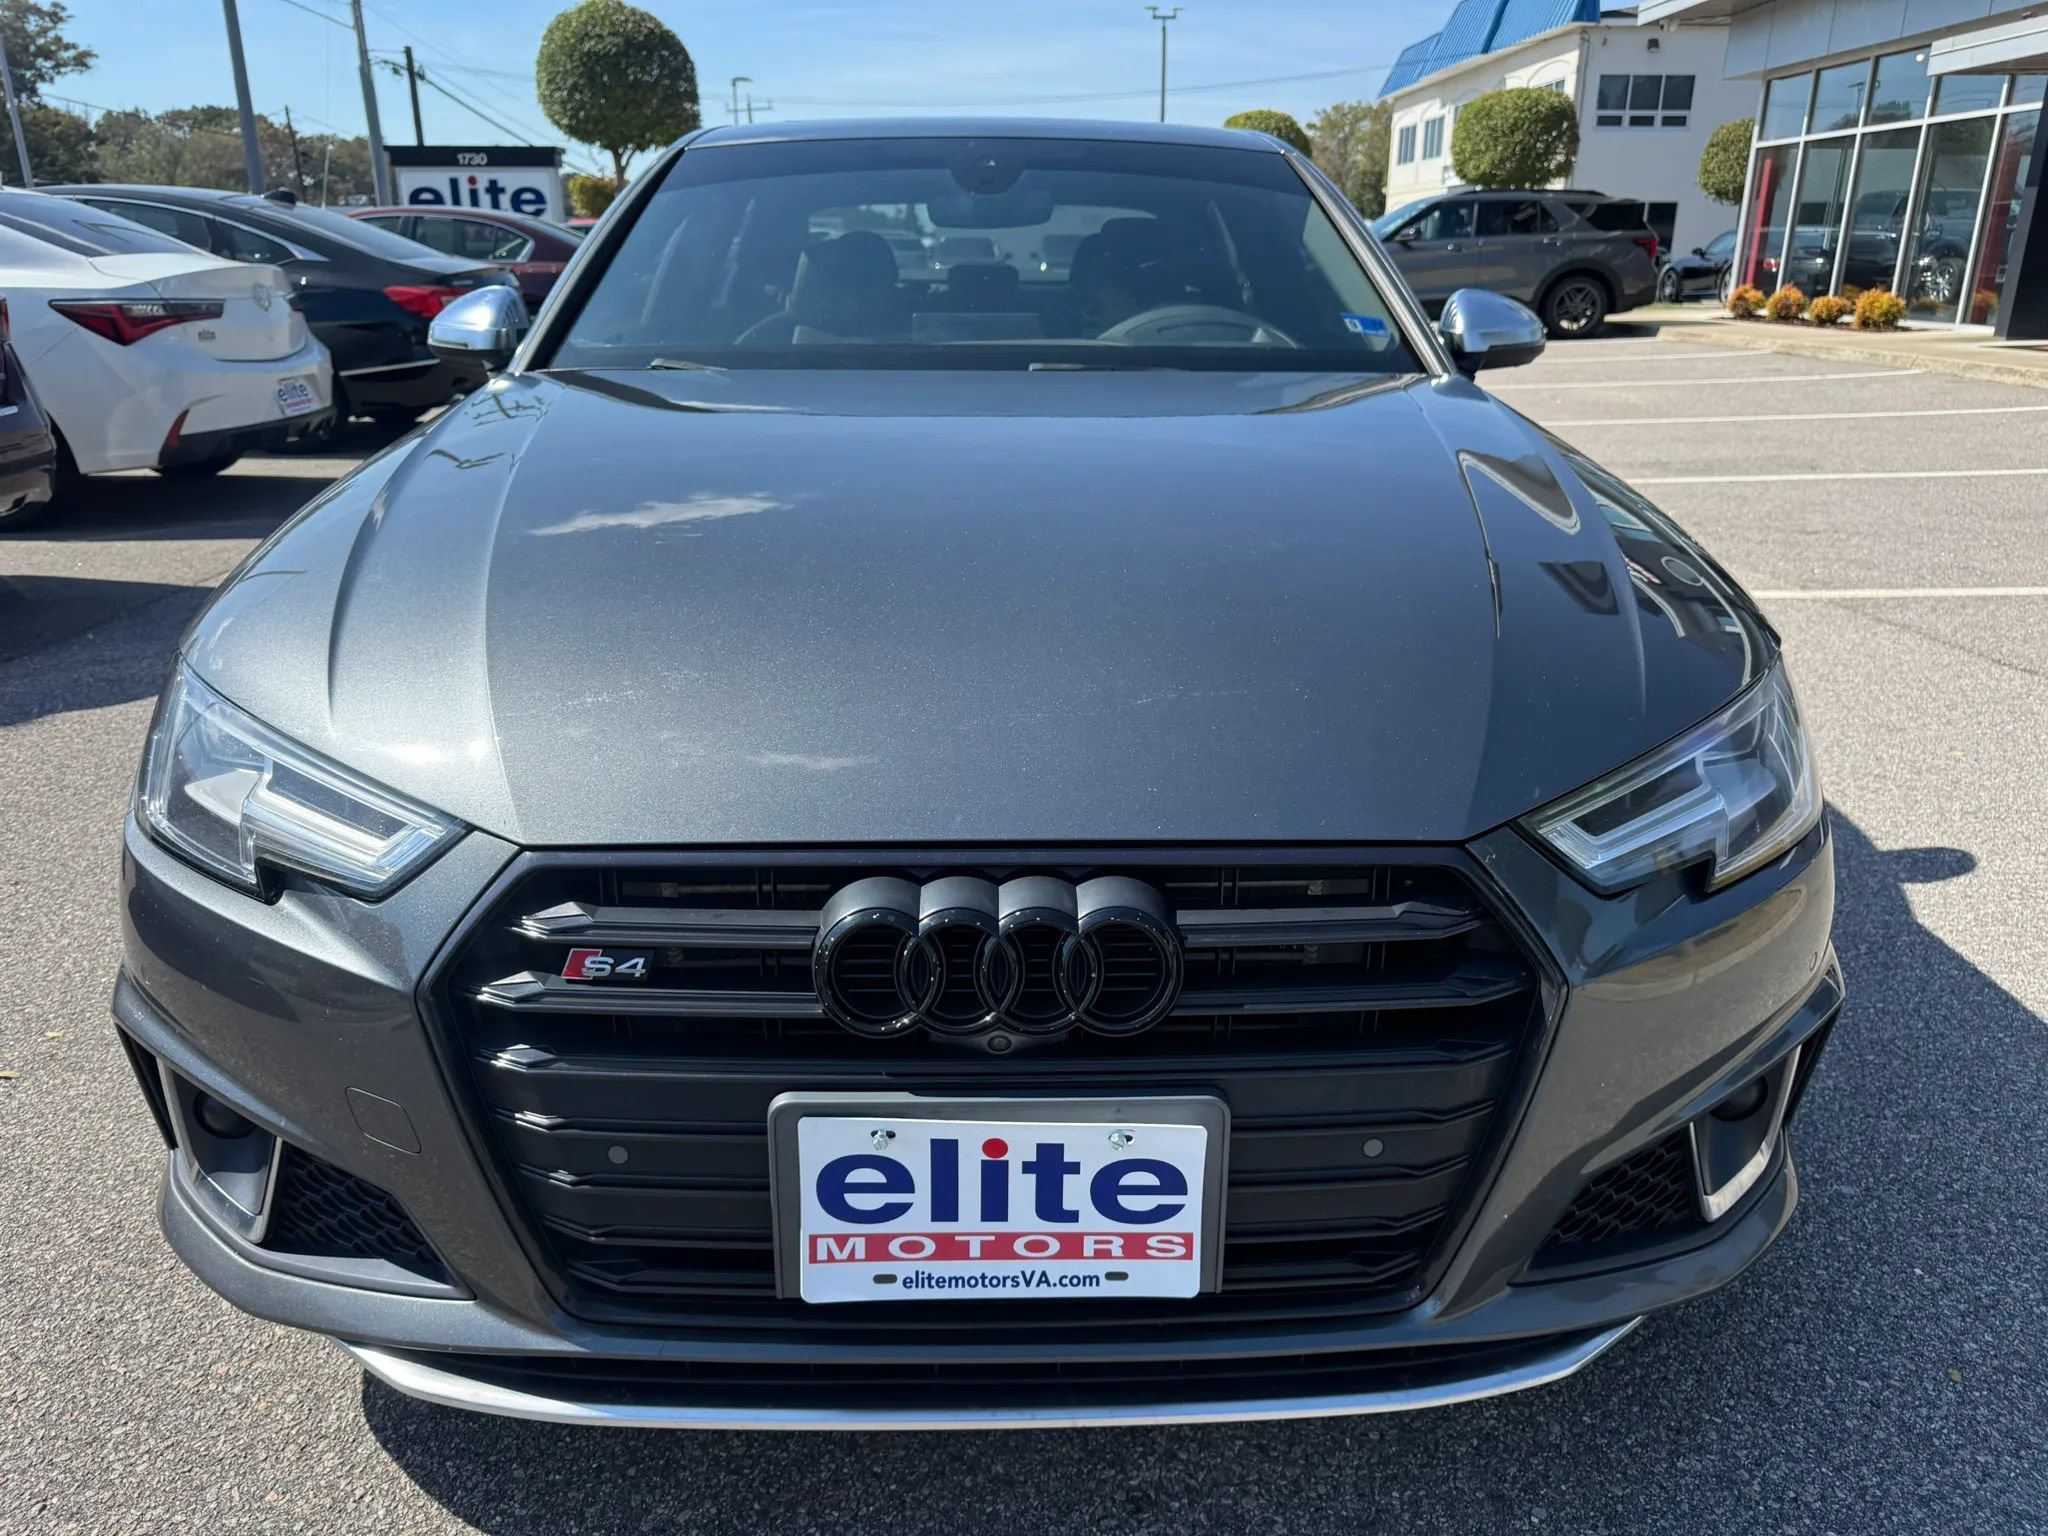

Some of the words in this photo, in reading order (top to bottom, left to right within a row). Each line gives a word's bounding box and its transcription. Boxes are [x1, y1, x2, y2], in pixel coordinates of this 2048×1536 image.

[457, 153, 488, 166] 1730
[409, 175, 547, 217] elite
[278, 383, 309, 402] elite
[581, 955, 646, 977] S4
[815, 1137, 1188, 1225] elite
[816, 1235, 1187, 1261] MOTORS
[902, 1270, 1100, 1289] elitemotorsVA.com
